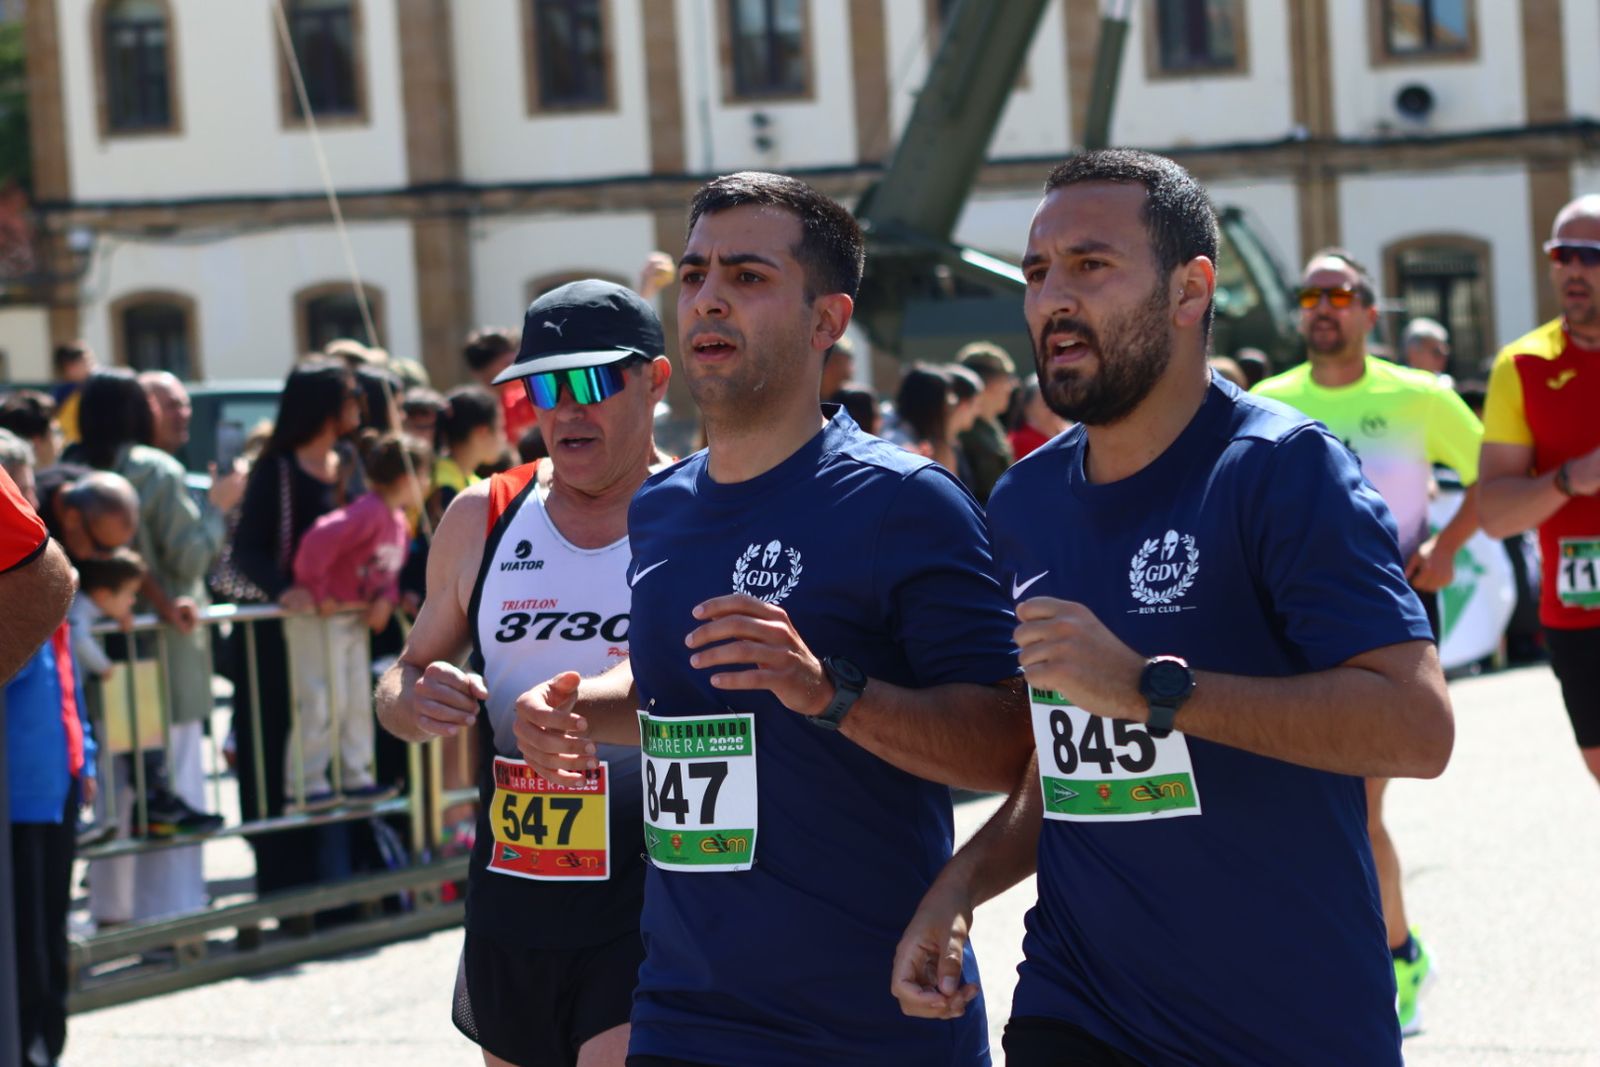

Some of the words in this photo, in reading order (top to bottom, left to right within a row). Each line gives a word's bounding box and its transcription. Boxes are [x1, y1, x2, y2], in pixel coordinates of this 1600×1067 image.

[501, 560, 544, 571] VIATOR
[1145, 562, 1185, 582] GDV
[746, 570, 786, 588] GDV
[502, 599, 558, 611] TRIATLON
[1139, 606, 1156, 614] RUN
[1158, 605, 1181, 613] CLUB
[669, 721, 747, 738] FERNANDO
[1050, 709, 1156, 774] 845
[646, 759, 728, 824] 847
[502, 794, 583, 845] 547
